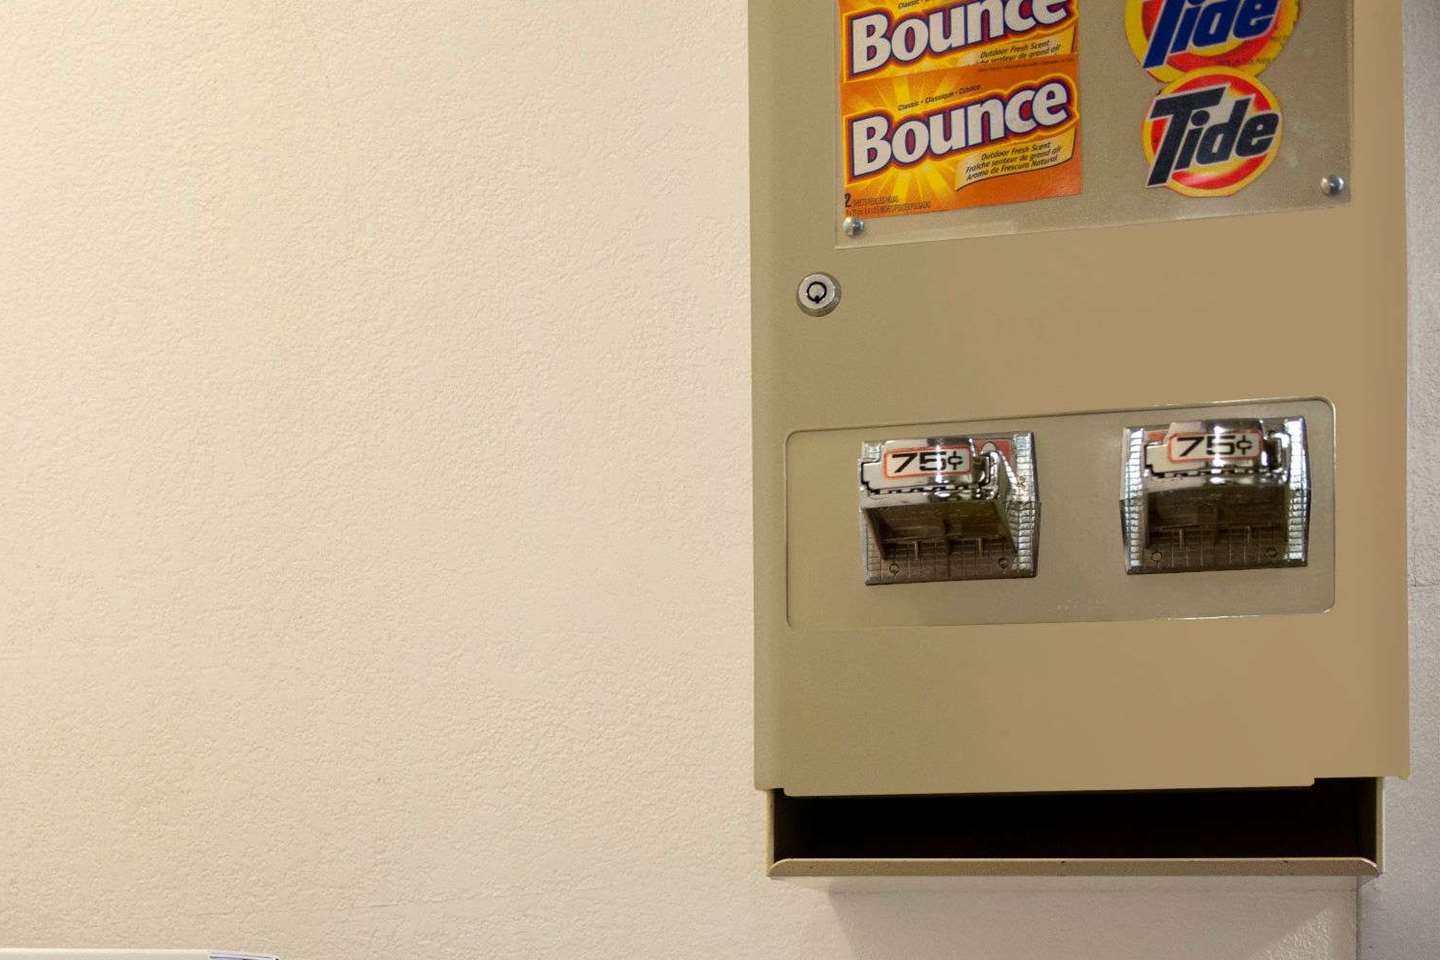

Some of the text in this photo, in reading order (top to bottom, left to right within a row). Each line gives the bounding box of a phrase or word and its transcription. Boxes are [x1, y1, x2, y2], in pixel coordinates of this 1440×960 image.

[852, 0, 1068, 74] Bounce
[853, 82, 1068, 177] Bounce
[1032, 141, 1051, 150] Scent
[1146, 85, 1280, 187] Tide
[891, 450, 964, 474] 75¢
[1176, 434, 1253, 457] 75¢
